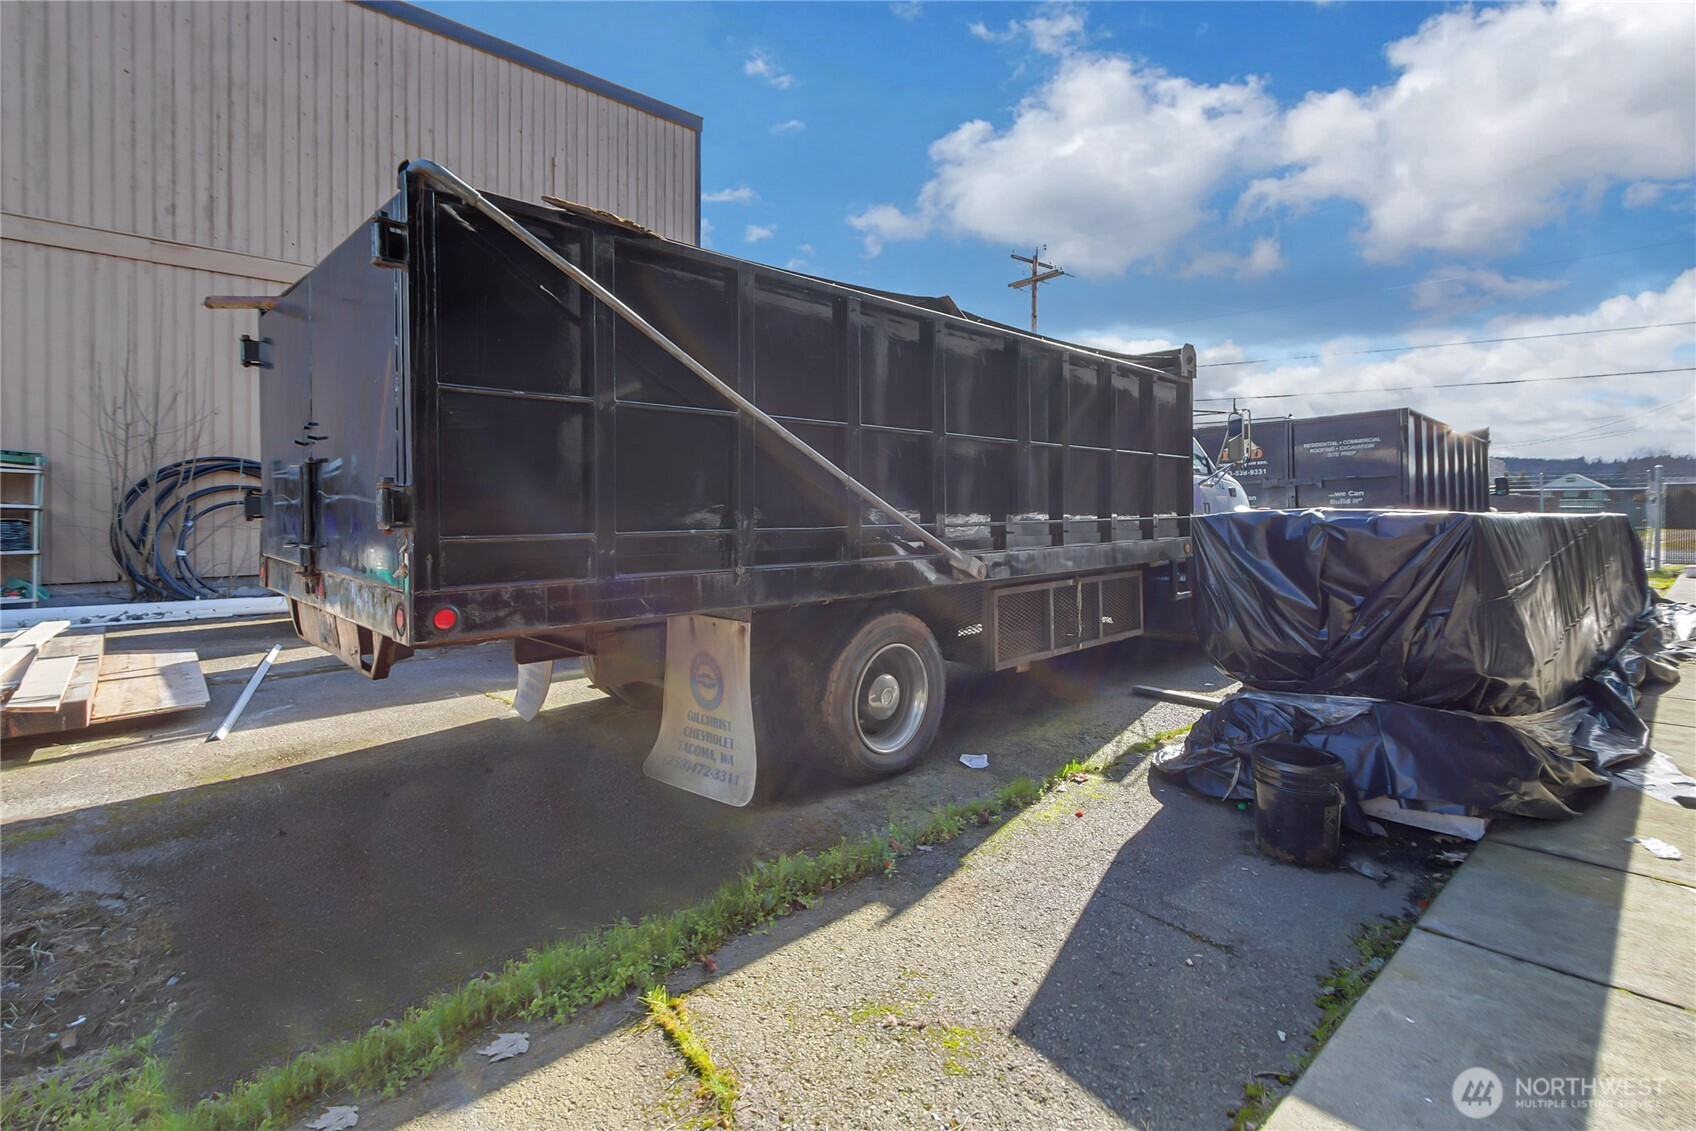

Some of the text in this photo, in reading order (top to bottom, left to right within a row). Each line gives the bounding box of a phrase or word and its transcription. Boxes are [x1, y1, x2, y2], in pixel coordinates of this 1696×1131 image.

[1339, 443, 1375, 451] EXCAVATION
[1342, 437, 1381, 445] COMMERCIAL
[687, 710, 733, 732] GILCHRIST
[683, 725, 735, 750] CHEVROLET
[720, 751, 734, 767] WA
